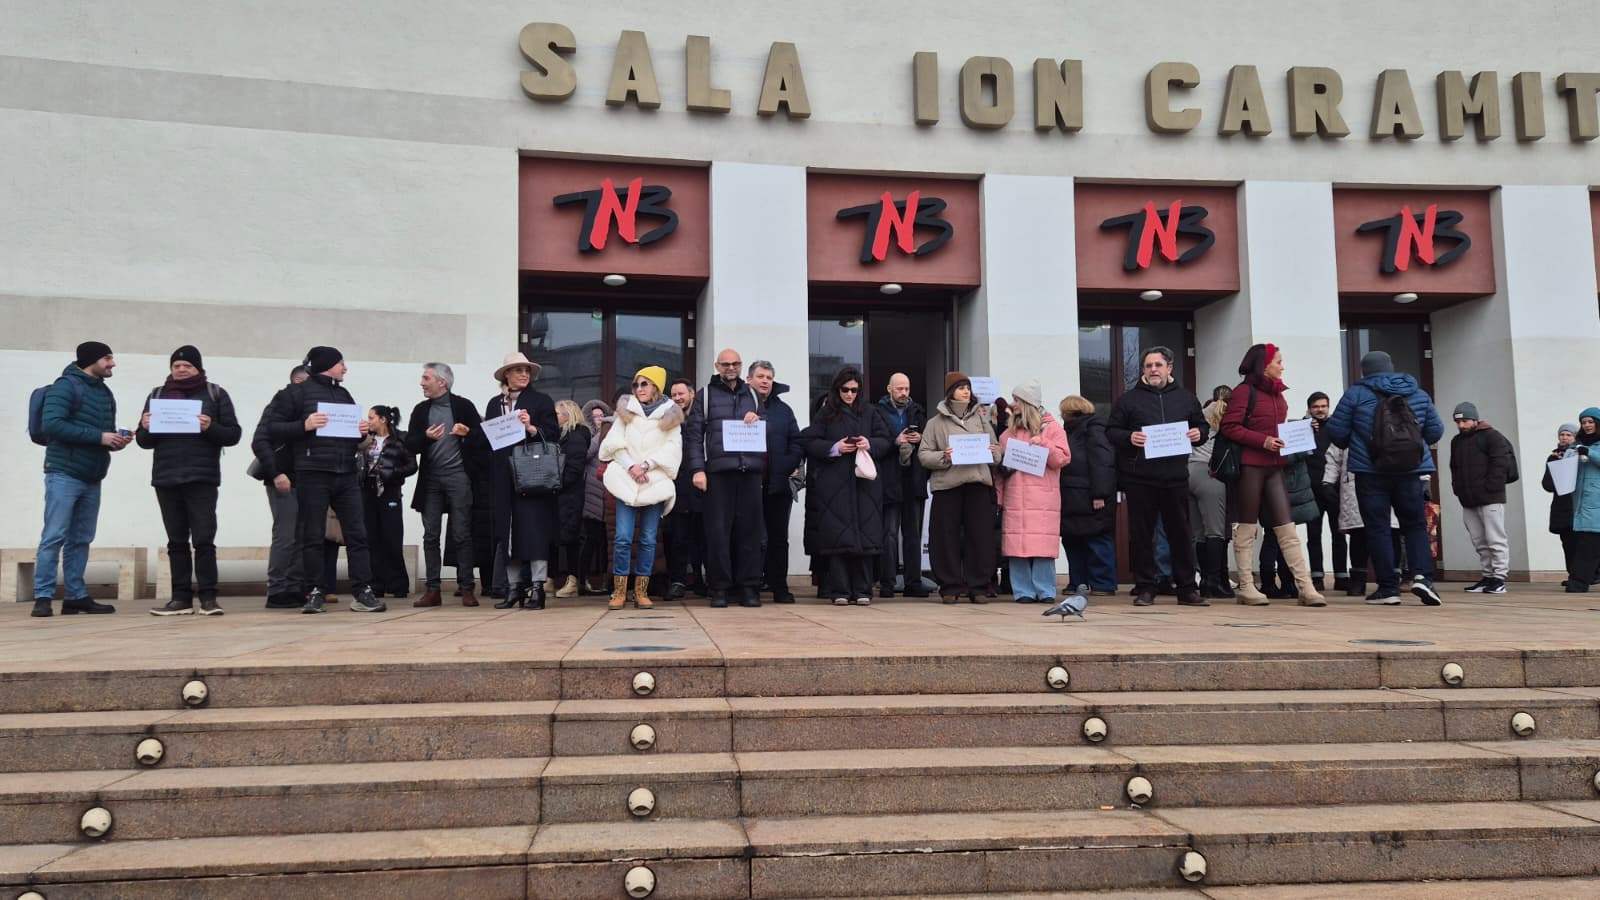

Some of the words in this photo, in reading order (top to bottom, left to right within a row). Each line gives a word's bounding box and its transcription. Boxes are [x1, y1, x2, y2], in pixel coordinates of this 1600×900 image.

[519, 22, 811, 118] SALA
[913, 51, 1084, 131] ION
[1145, 61, 1600, 141] CARAMIT
[553, 177, 679, 253] TNB
[836, 189, 954, 264] TNB
[1101, 200, 1216, 272] TNB
[1356, 204, 1471, 273] TNB
